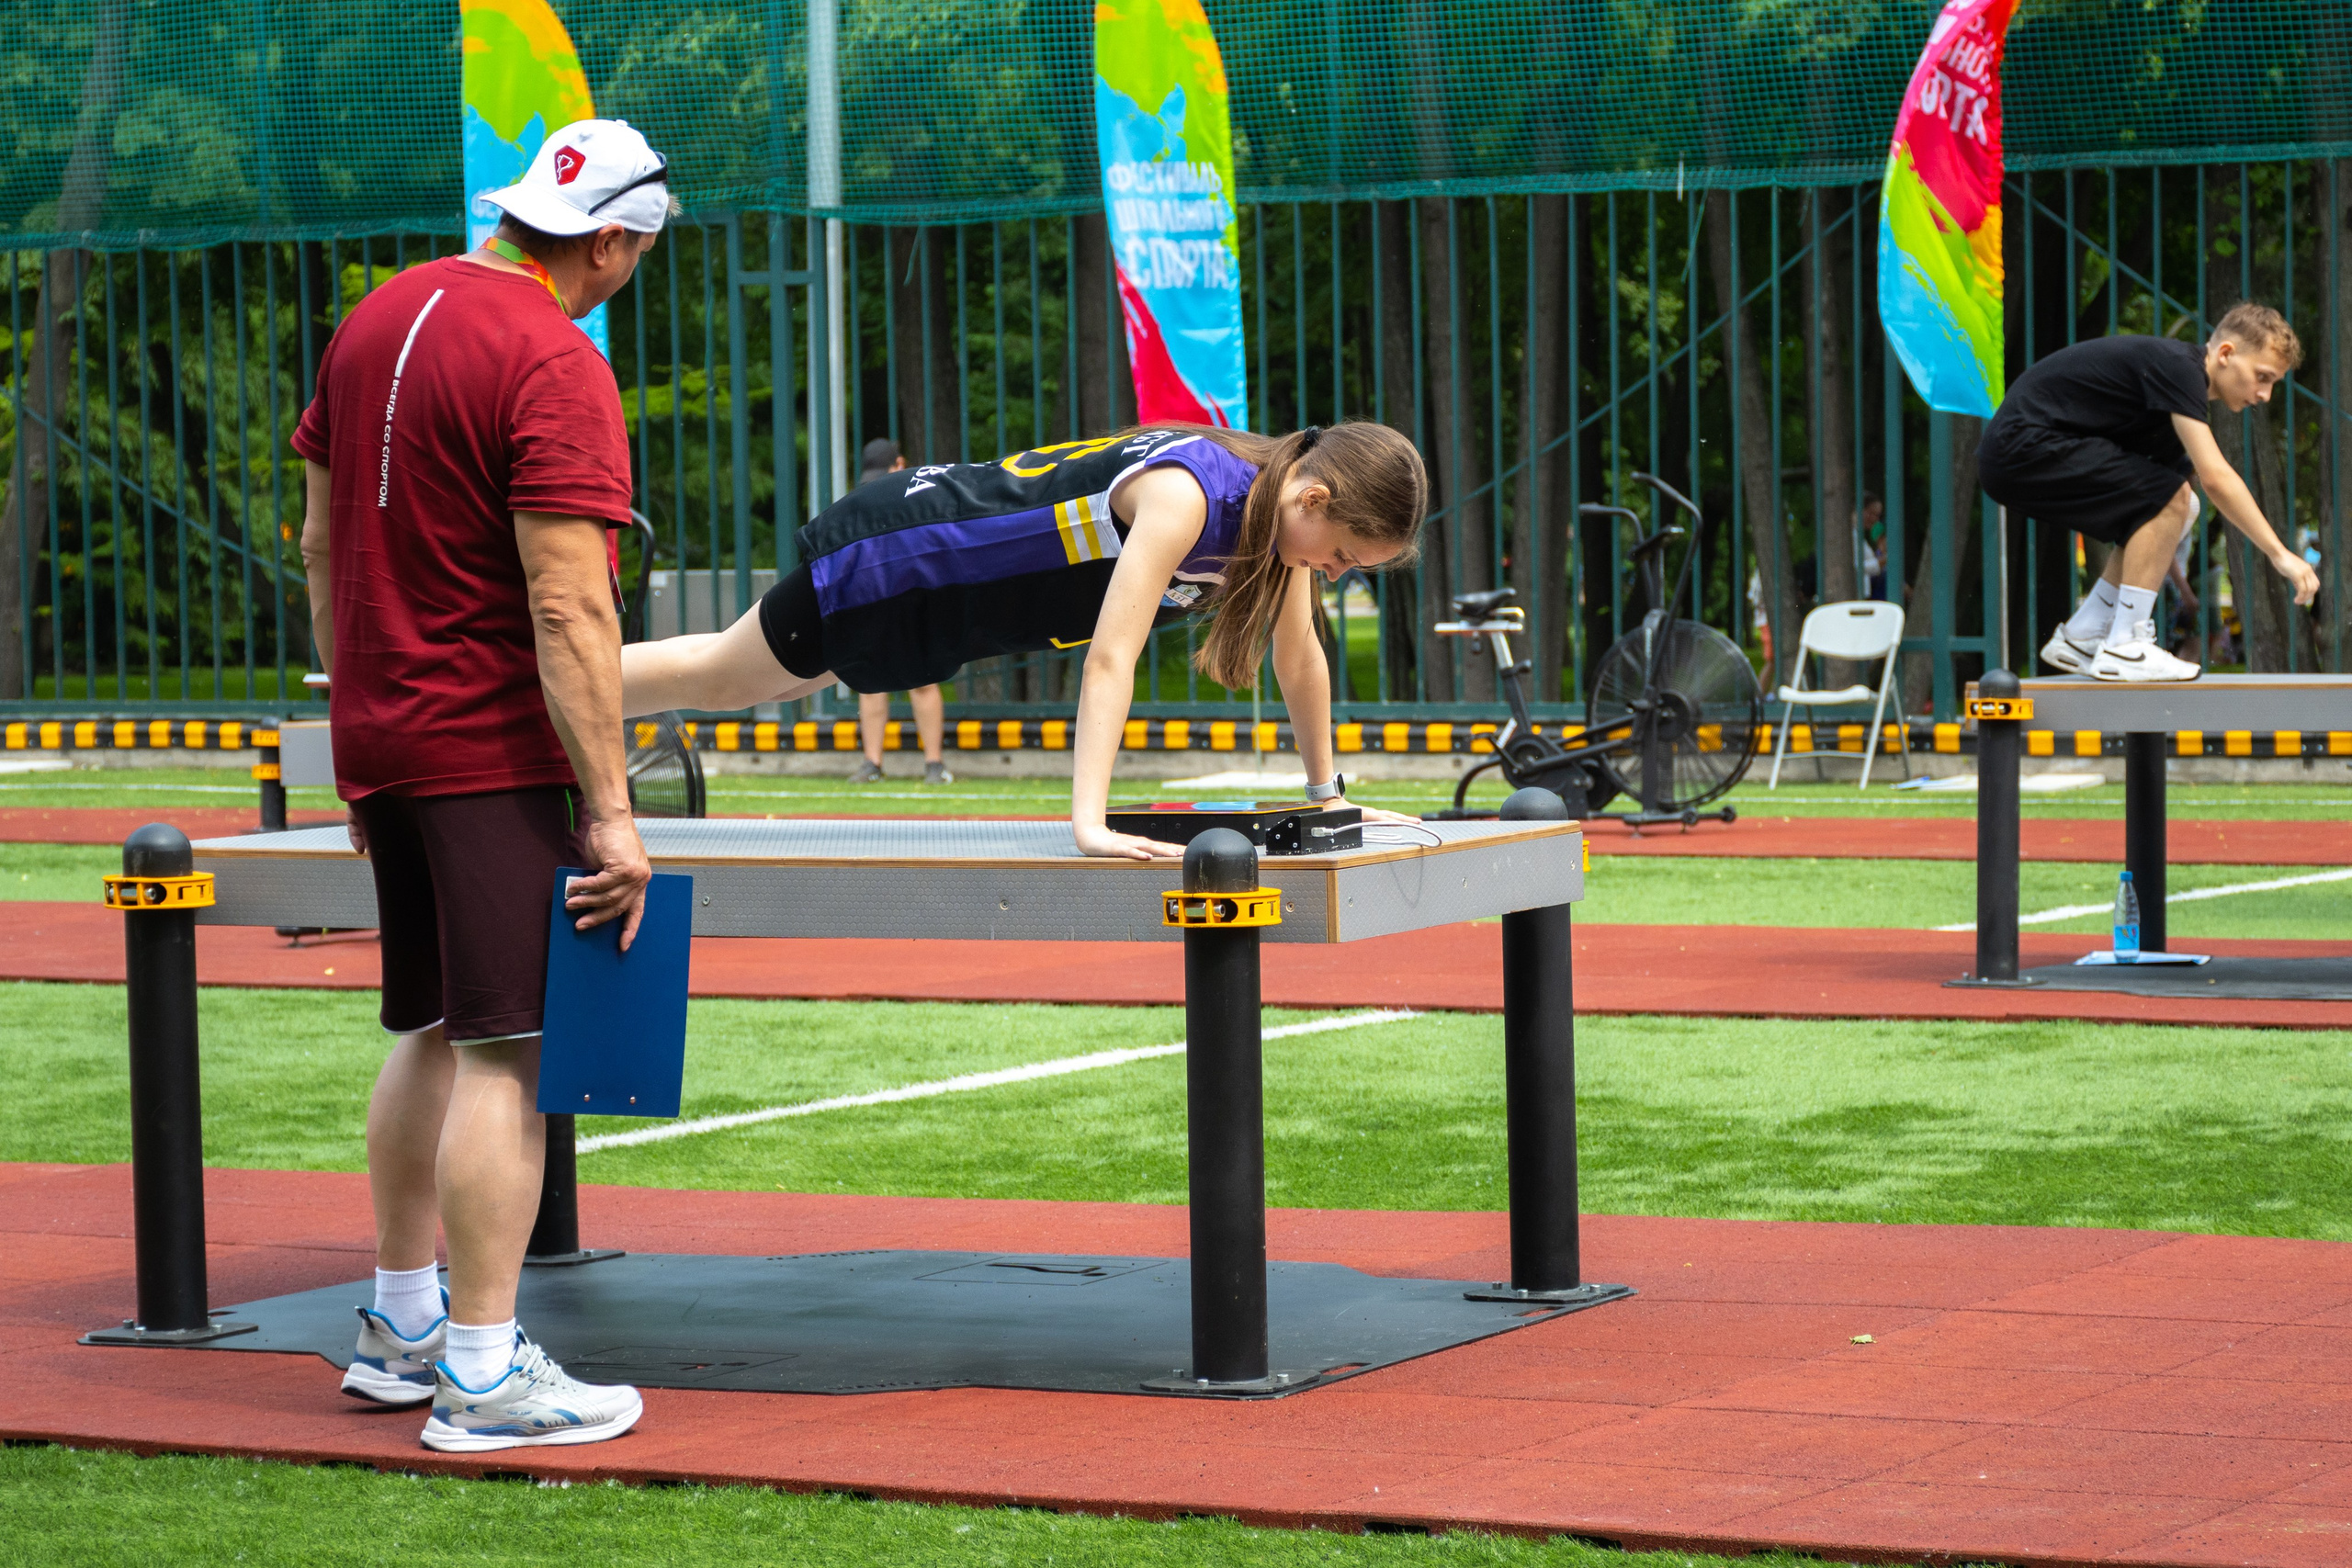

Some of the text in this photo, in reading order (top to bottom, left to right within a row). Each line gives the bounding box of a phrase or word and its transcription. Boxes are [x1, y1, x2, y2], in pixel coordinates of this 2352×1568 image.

[378, 379, 401, 507] ВСЕГДА СО СПОРТОМ
